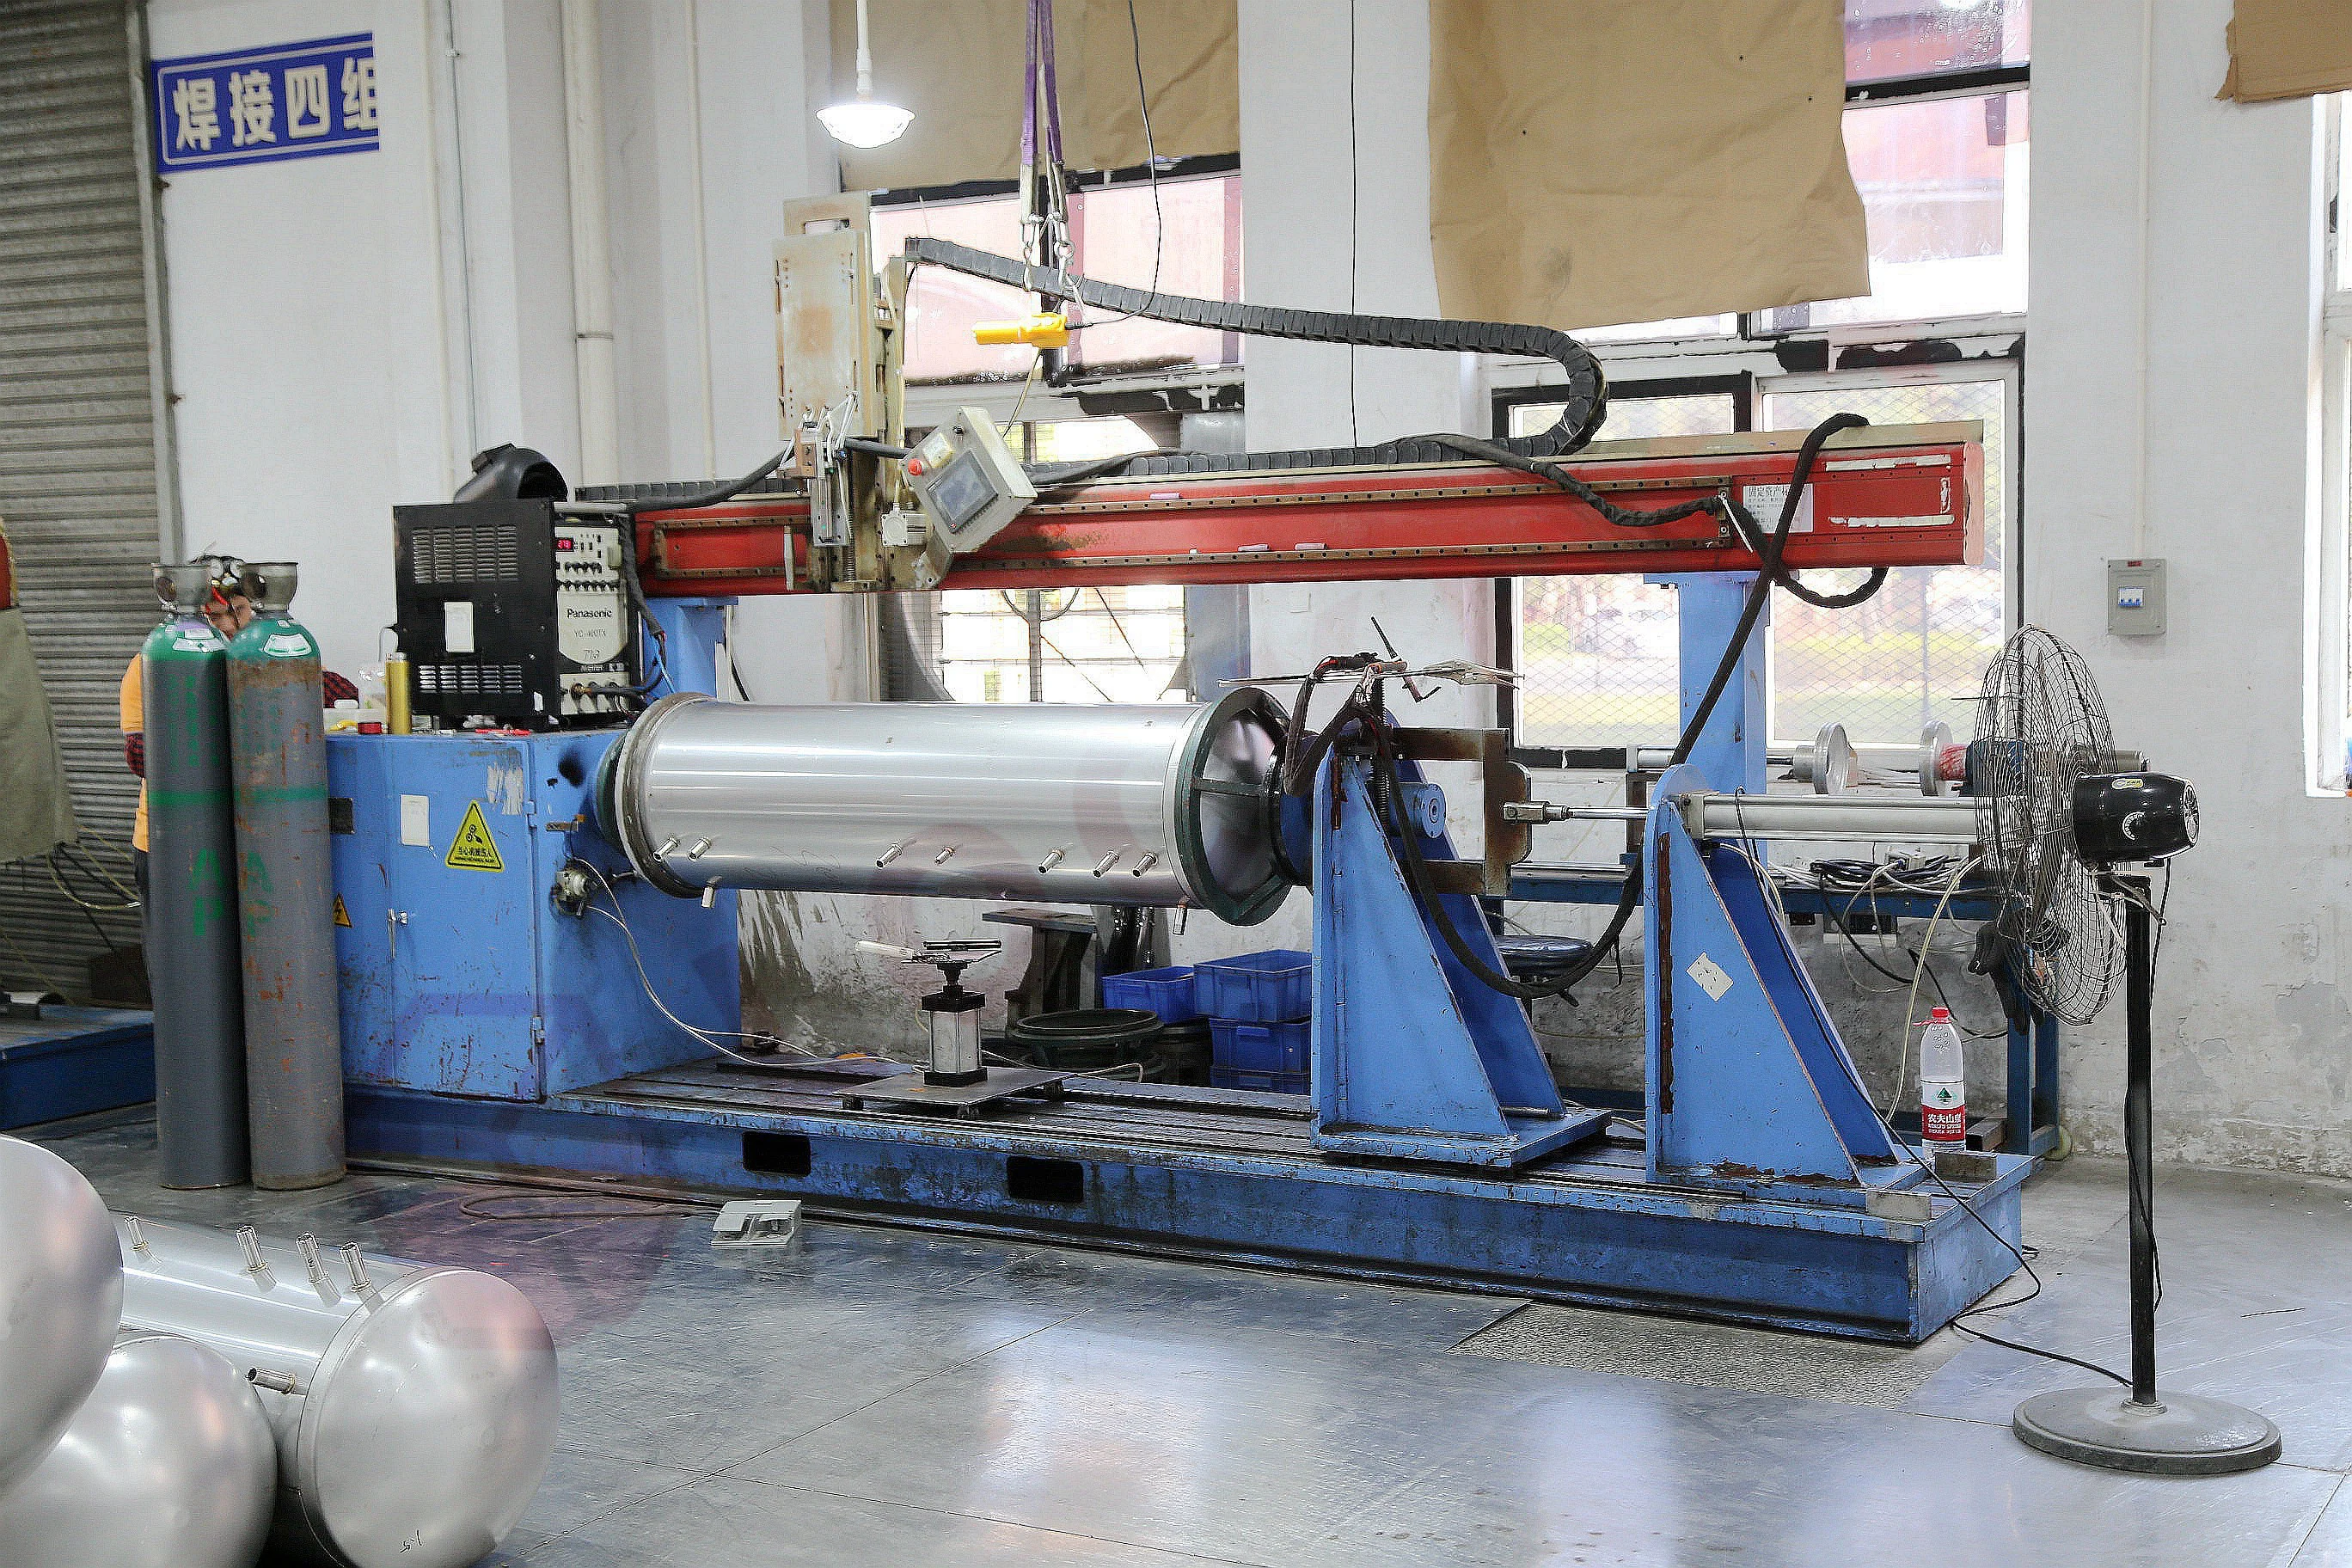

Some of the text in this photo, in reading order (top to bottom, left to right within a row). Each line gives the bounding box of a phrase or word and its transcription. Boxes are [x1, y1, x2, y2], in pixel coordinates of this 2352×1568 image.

[567, 607, 612, 619] Panasonic
[1927, 1112, 1962, 1124] 农夫山泉
